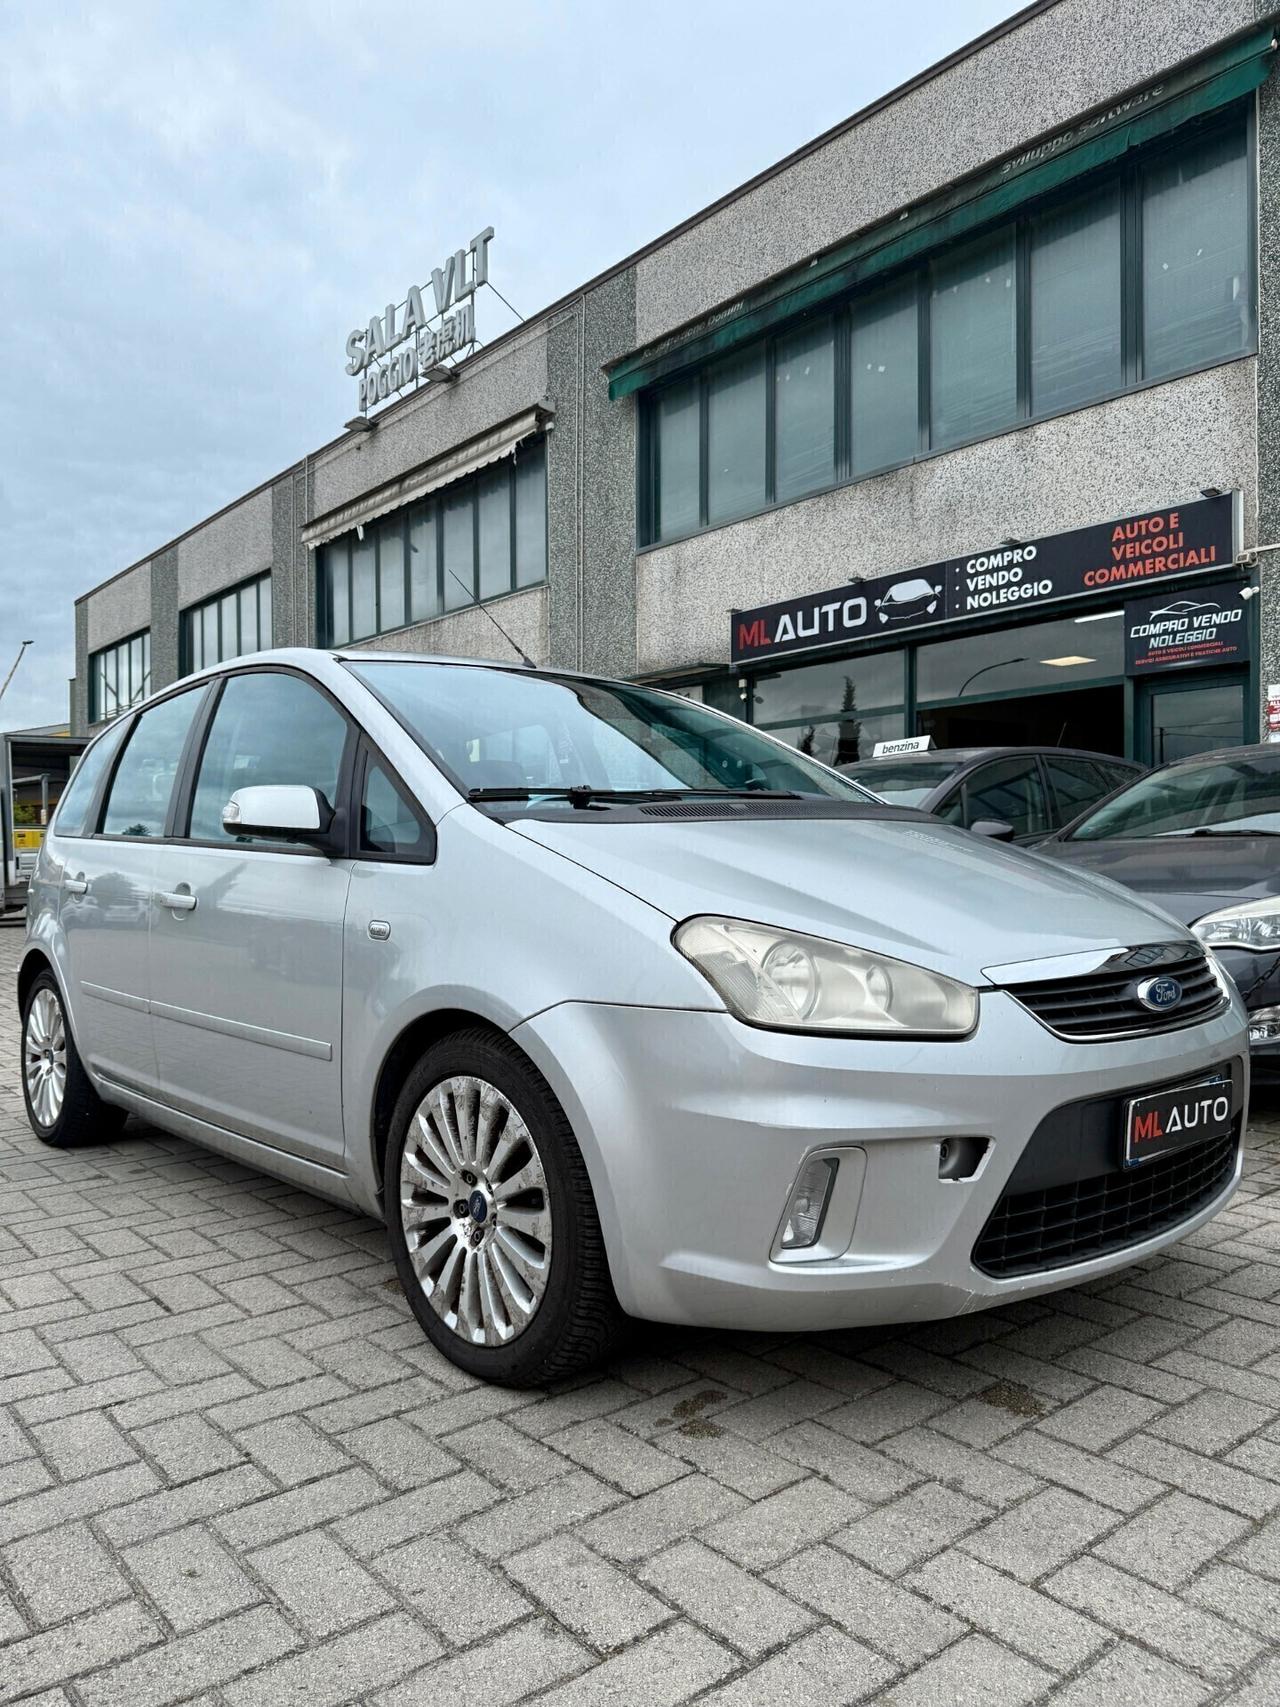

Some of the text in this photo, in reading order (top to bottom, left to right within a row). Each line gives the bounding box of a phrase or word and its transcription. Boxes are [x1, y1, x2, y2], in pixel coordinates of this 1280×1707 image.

[345, 226, 495, 376] SALA VLT
[418, 304, 476, 370] 老虎机
[358, 347, 418, 412] POGGIO
[1111, 512, 1179, 542] AUTO E
[966, 545, 1037, 574] COMPRO
[1111, 532, 1184, 561] VEICOLI
[966, 567, 1023, 592] VENDO
[1083, 545, 1216, 587] COMMERCIALI
[966, 579, 1053, 610] NOLEGGIO
[1130, 609, 1242, 638] COMPRO VENDO
[1148, 627, 1217, 649] NOLEGGIO
[882, 739, 920, 754] benzina
[1155, 982, 1177, 1003] Ford
